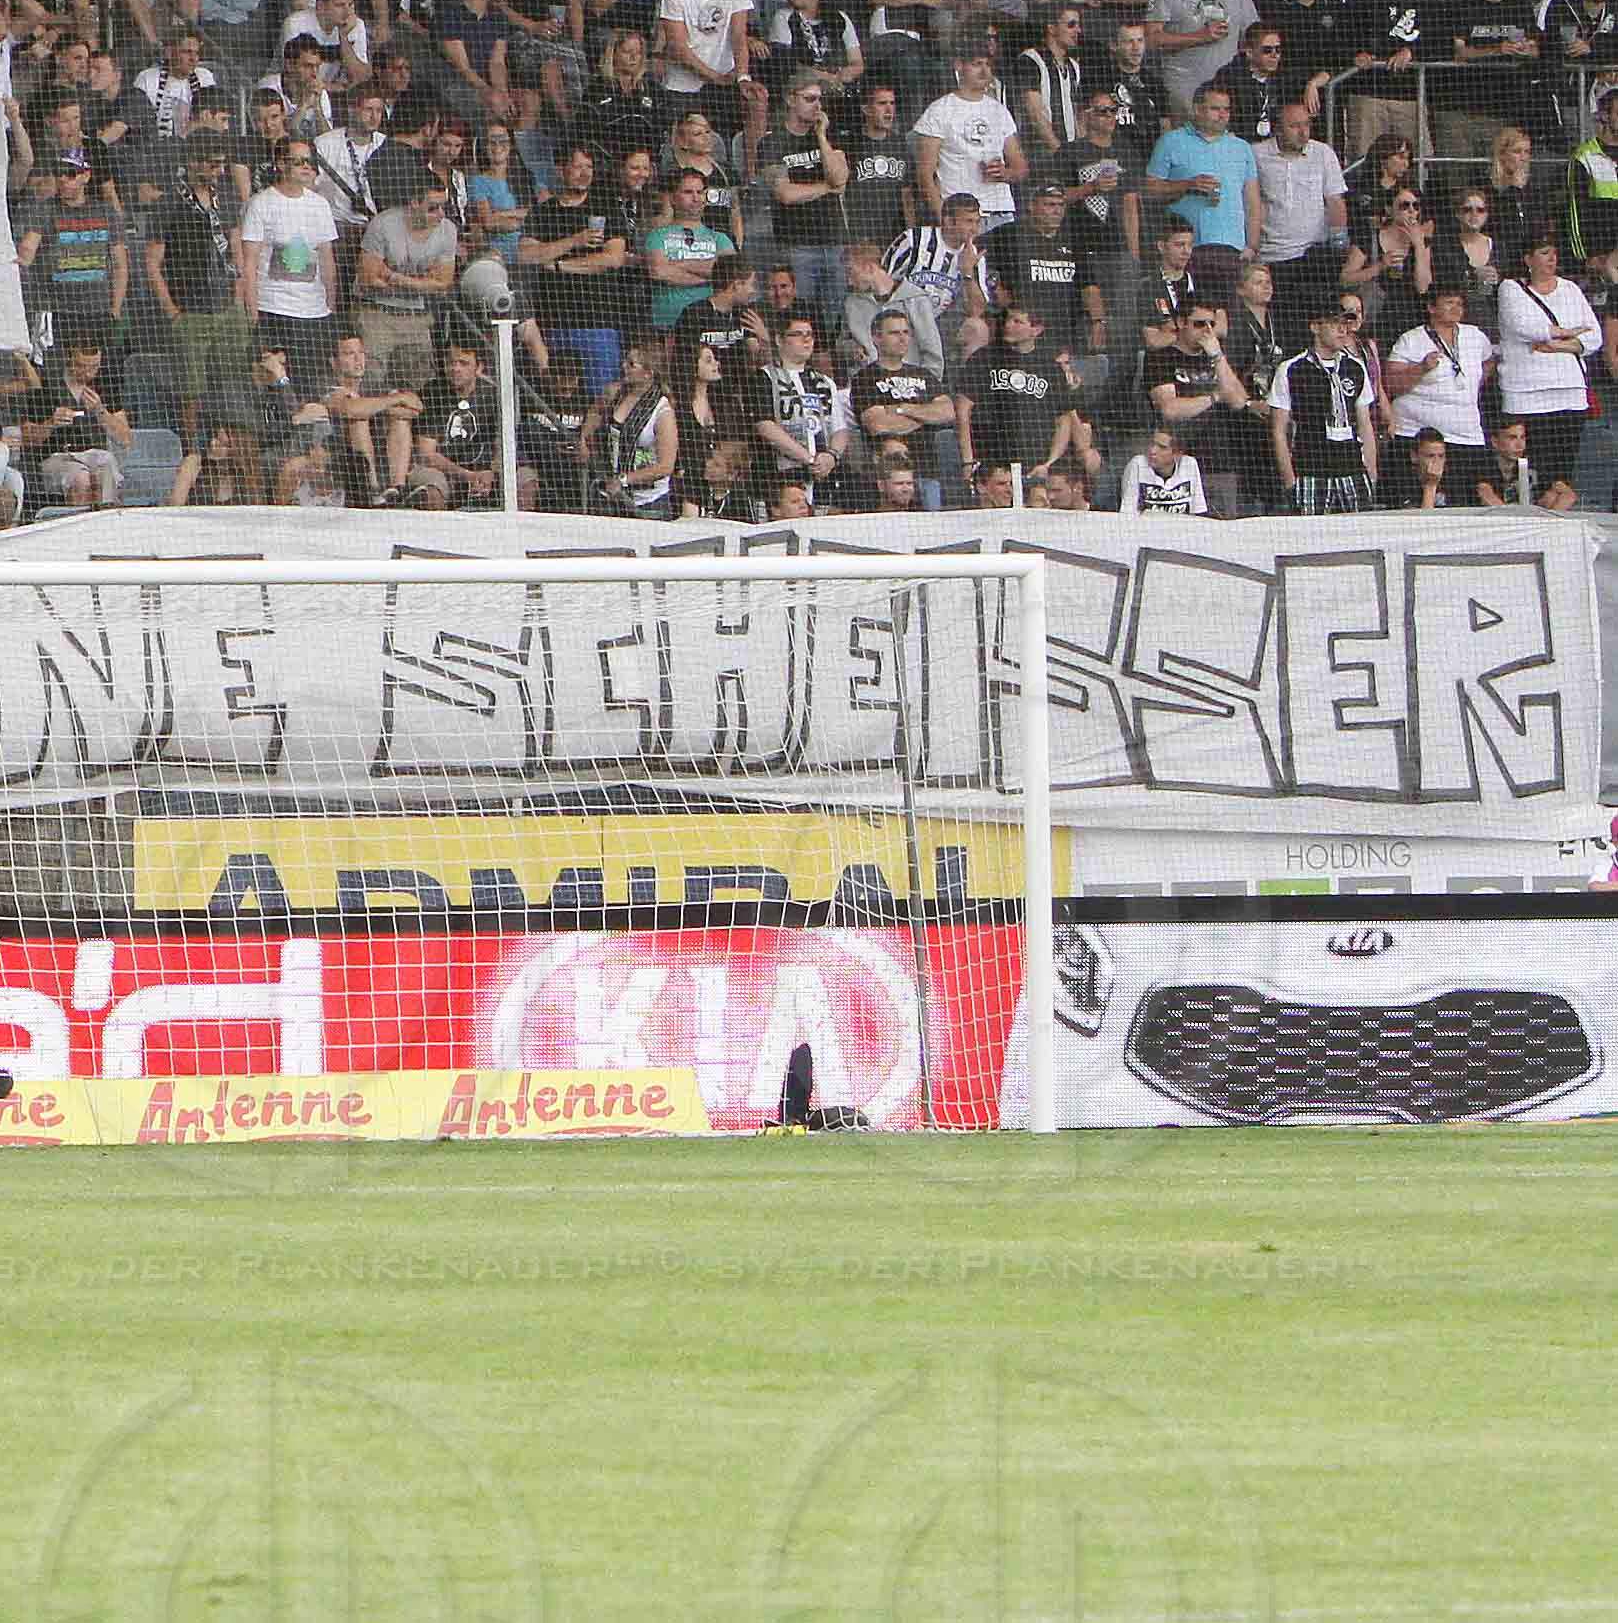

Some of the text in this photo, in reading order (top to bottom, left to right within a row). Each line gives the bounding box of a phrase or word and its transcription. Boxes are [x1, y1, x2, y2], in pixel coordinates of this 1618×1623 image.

[372, 529, 1565, 803] SCHEISSER
[1284, 839, 1412, 871] HOLDING
[136, 1079, 372, 1144] Antenne
[439, 1073, 674, 1137] Antenne
